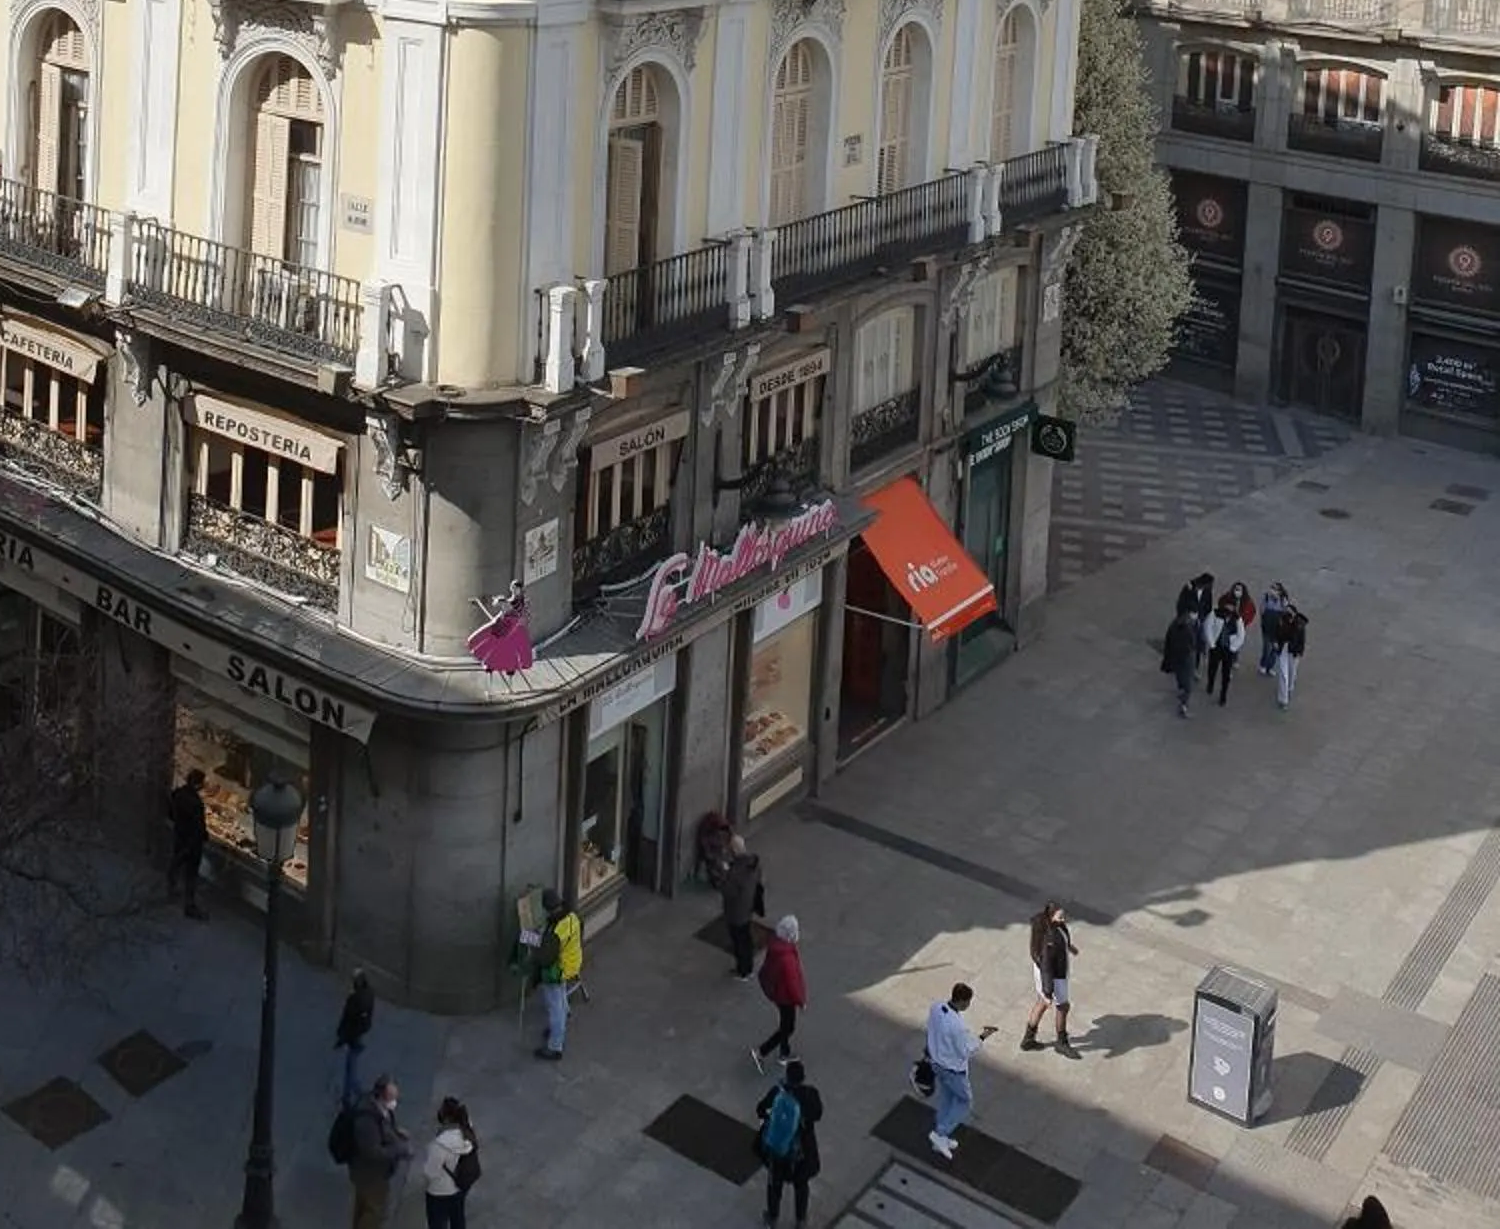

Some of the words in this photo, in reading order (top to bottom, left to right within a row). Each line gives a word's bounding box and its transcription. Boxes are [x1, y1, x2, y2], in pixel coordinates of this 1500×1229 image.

[1, 331, 74, 370] CAFETERÍA
[759, 370, 796, 395] DESDE
[203, 410, 313, 461] REPOSTERÍA
[907, 562, 939, 593] ria
[96, 586, 153, 636] BAR
[226, 653, 347, 730] SALON
